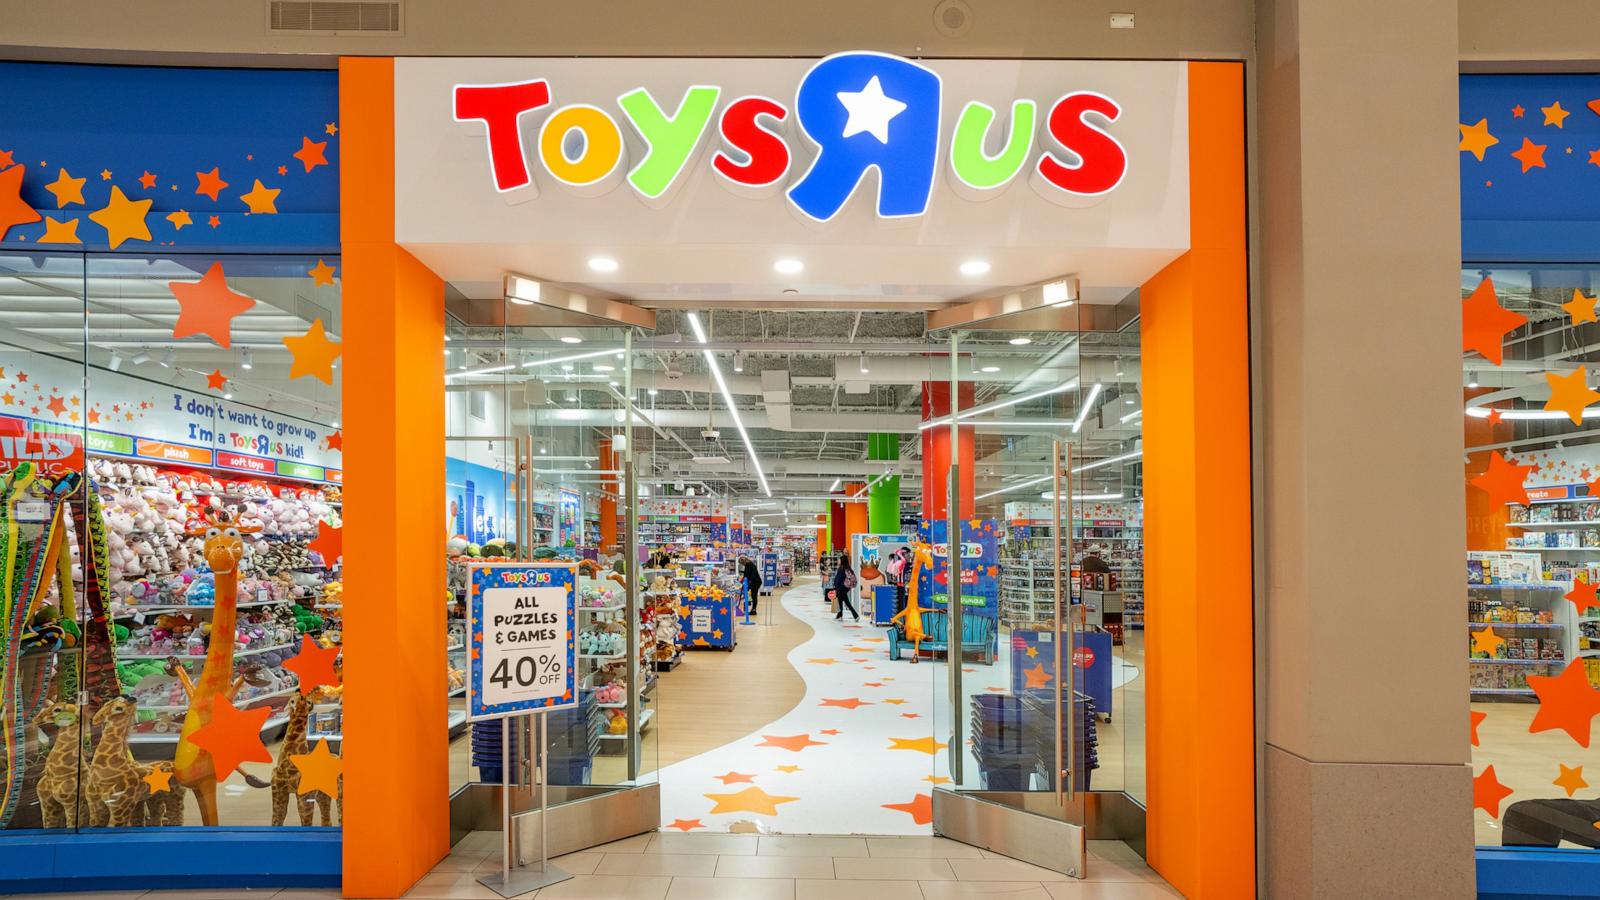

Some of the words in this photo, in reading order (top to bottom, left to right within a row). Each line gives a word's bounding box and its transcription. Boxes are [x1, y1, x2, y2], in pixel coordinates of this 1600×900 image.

[174, 394, 182, 411] I
[187, 399, 224, 420] don't
[228, 410, 258, 427] want
[261, 415, 274, 430] to
[277, 422, 301, 436] grow
[305, 429, 317, 442] up
[189, 423, 212, 442] I'm
[218, 433, 226, 444] a
[286, 444, 304, 459] kid!
[164, 448, 190, 459] plush
[230, 458, 247, 468] soft
[248, 461, 264, 471] toys
[1526, 491, 1549, 499] reate
[514, 596, 539, 610] ALL
[494, 612, 558, 627] PUZZLES
[507, 629, 556, 643] GAMES
[489, 654, 561, 689] 40%
[539, 674, 561, 685] OFF
